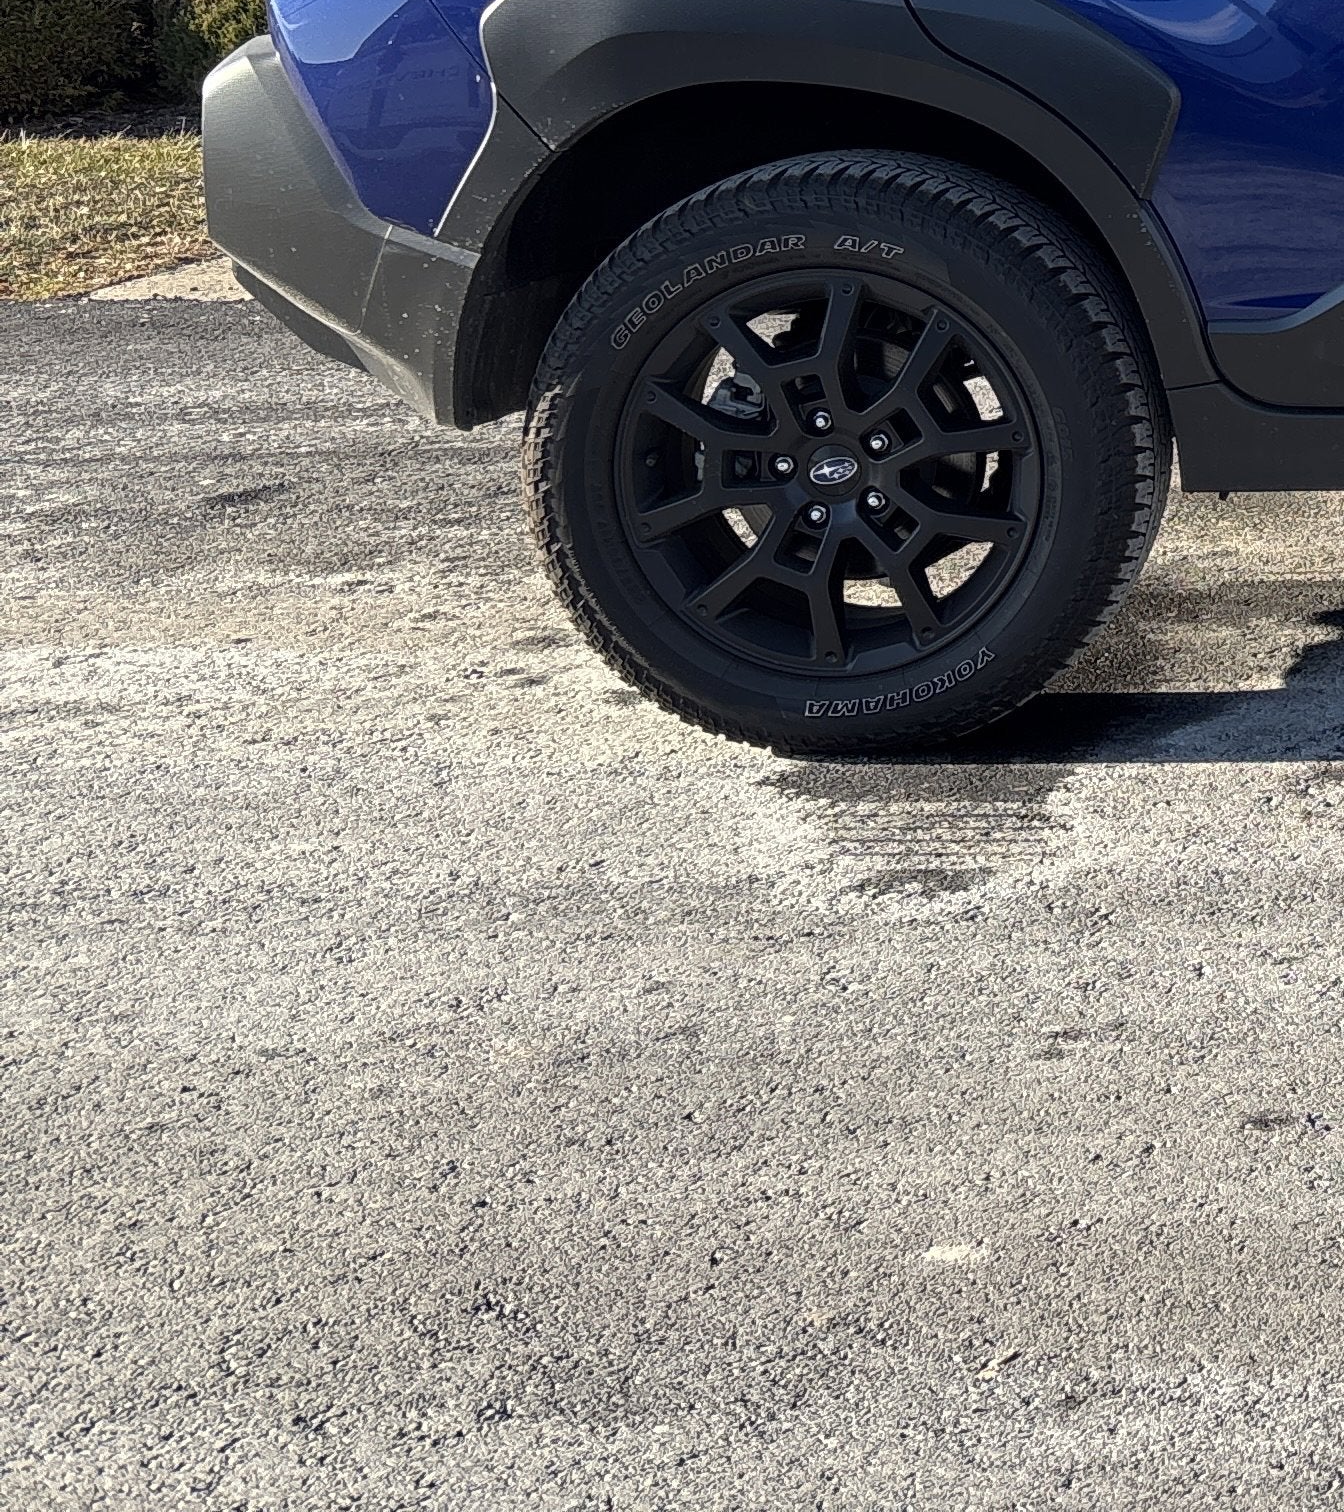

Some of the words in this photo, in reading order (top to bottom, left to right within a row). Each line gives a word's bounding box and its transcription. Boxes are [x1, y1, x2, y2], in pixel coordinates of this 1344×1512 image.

[611, 235, 806, 350] GEOLANDAR
[834, 235, 905, 259] A/T
[804, 648, 995, 717] YOKOHAMA
